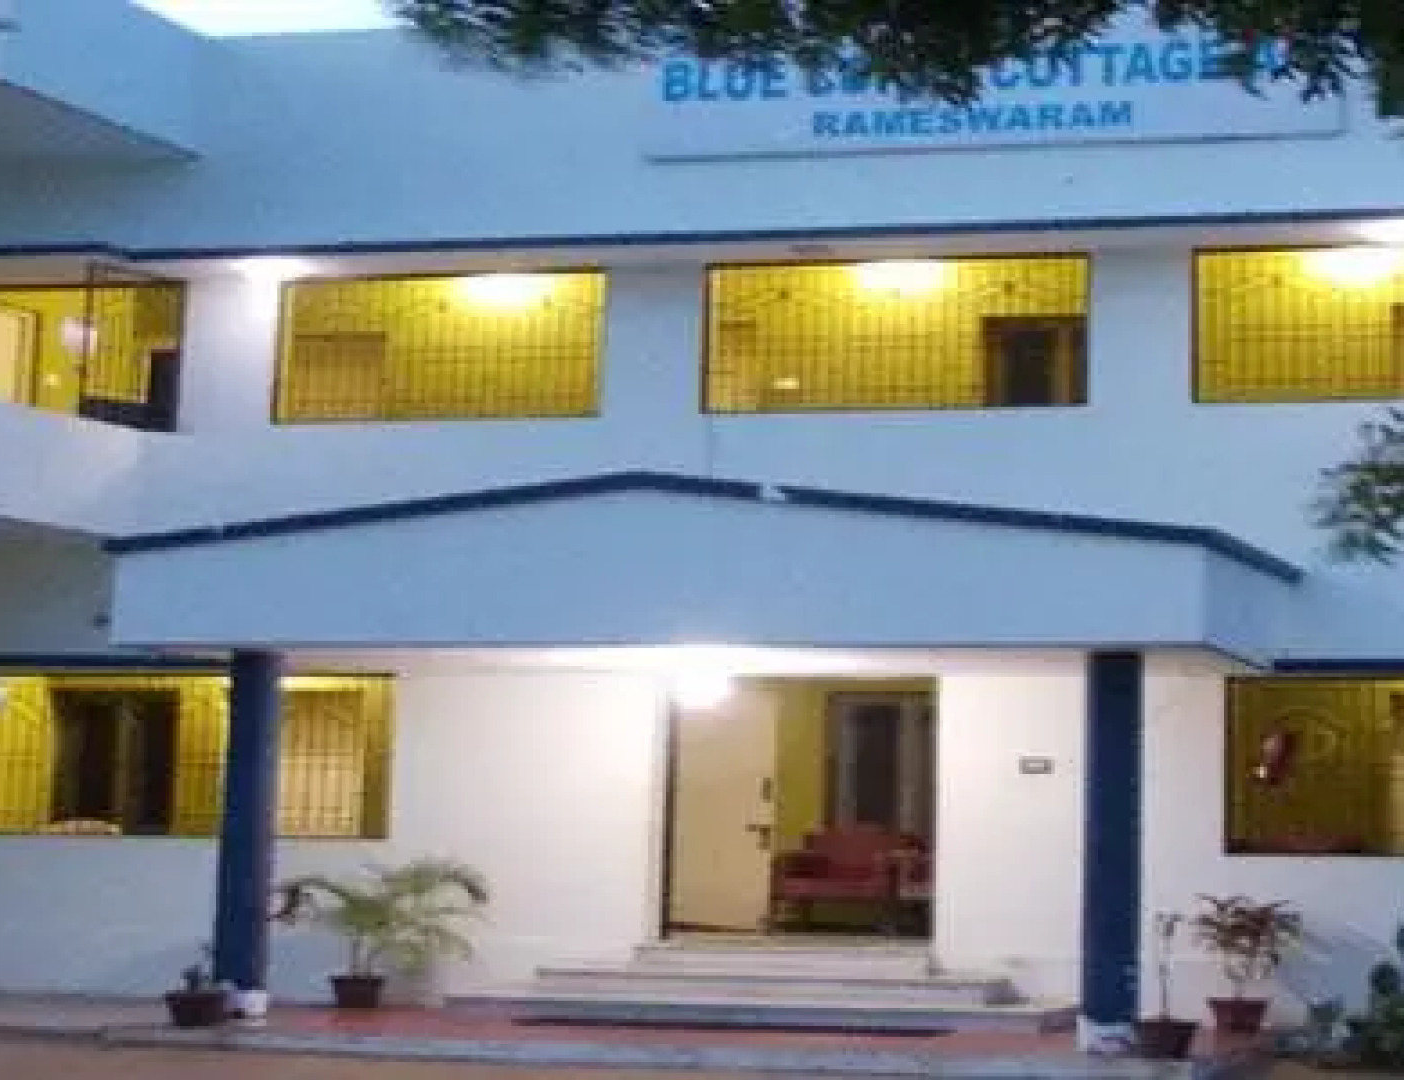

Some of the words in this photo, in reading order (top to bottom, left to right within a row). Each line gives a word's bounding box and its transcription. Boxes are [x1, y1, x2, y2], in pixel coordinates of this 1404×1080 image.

[662, 56, 788, 102] BLUE
[992, 40, 1226, 89] COTTAGE
[811, 101, 1133, 137] RAMESWARAM
